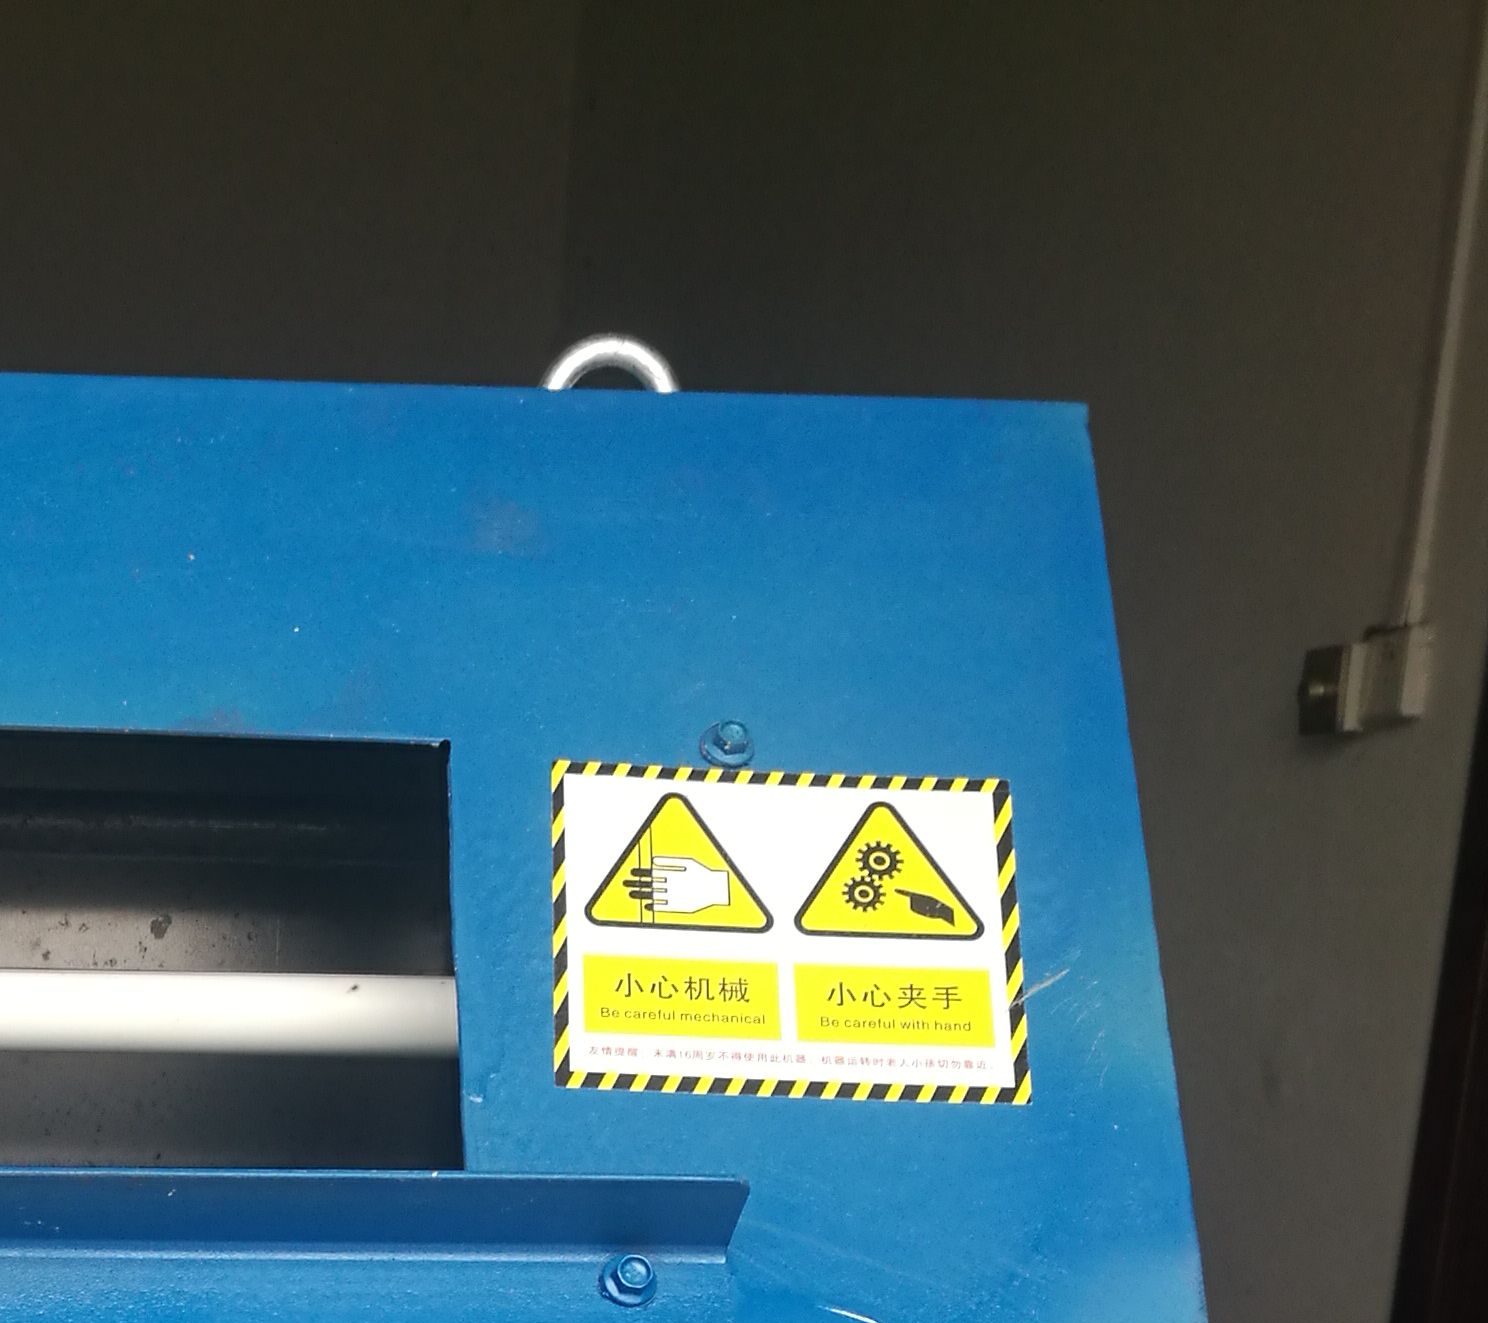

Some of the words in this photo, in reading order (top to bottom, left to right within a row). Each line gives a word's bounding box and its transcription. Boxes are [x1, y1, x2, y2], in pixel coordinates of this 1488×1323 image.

[615, 972, 750, 1003] 小心机械
[827, 981, 963, 1010] 小心夹手
[600, 1007, 620, 1018] Be
[624, 1009, 676, 1021] careful
[680, 1011, 766, 1025] mechanical
[820, 1016, 840, 1027] Be
[844, 1018, 896, 1029] careful
[900, 1019, 930, 1031] with
[934, 1020, 972, 1032] hand
